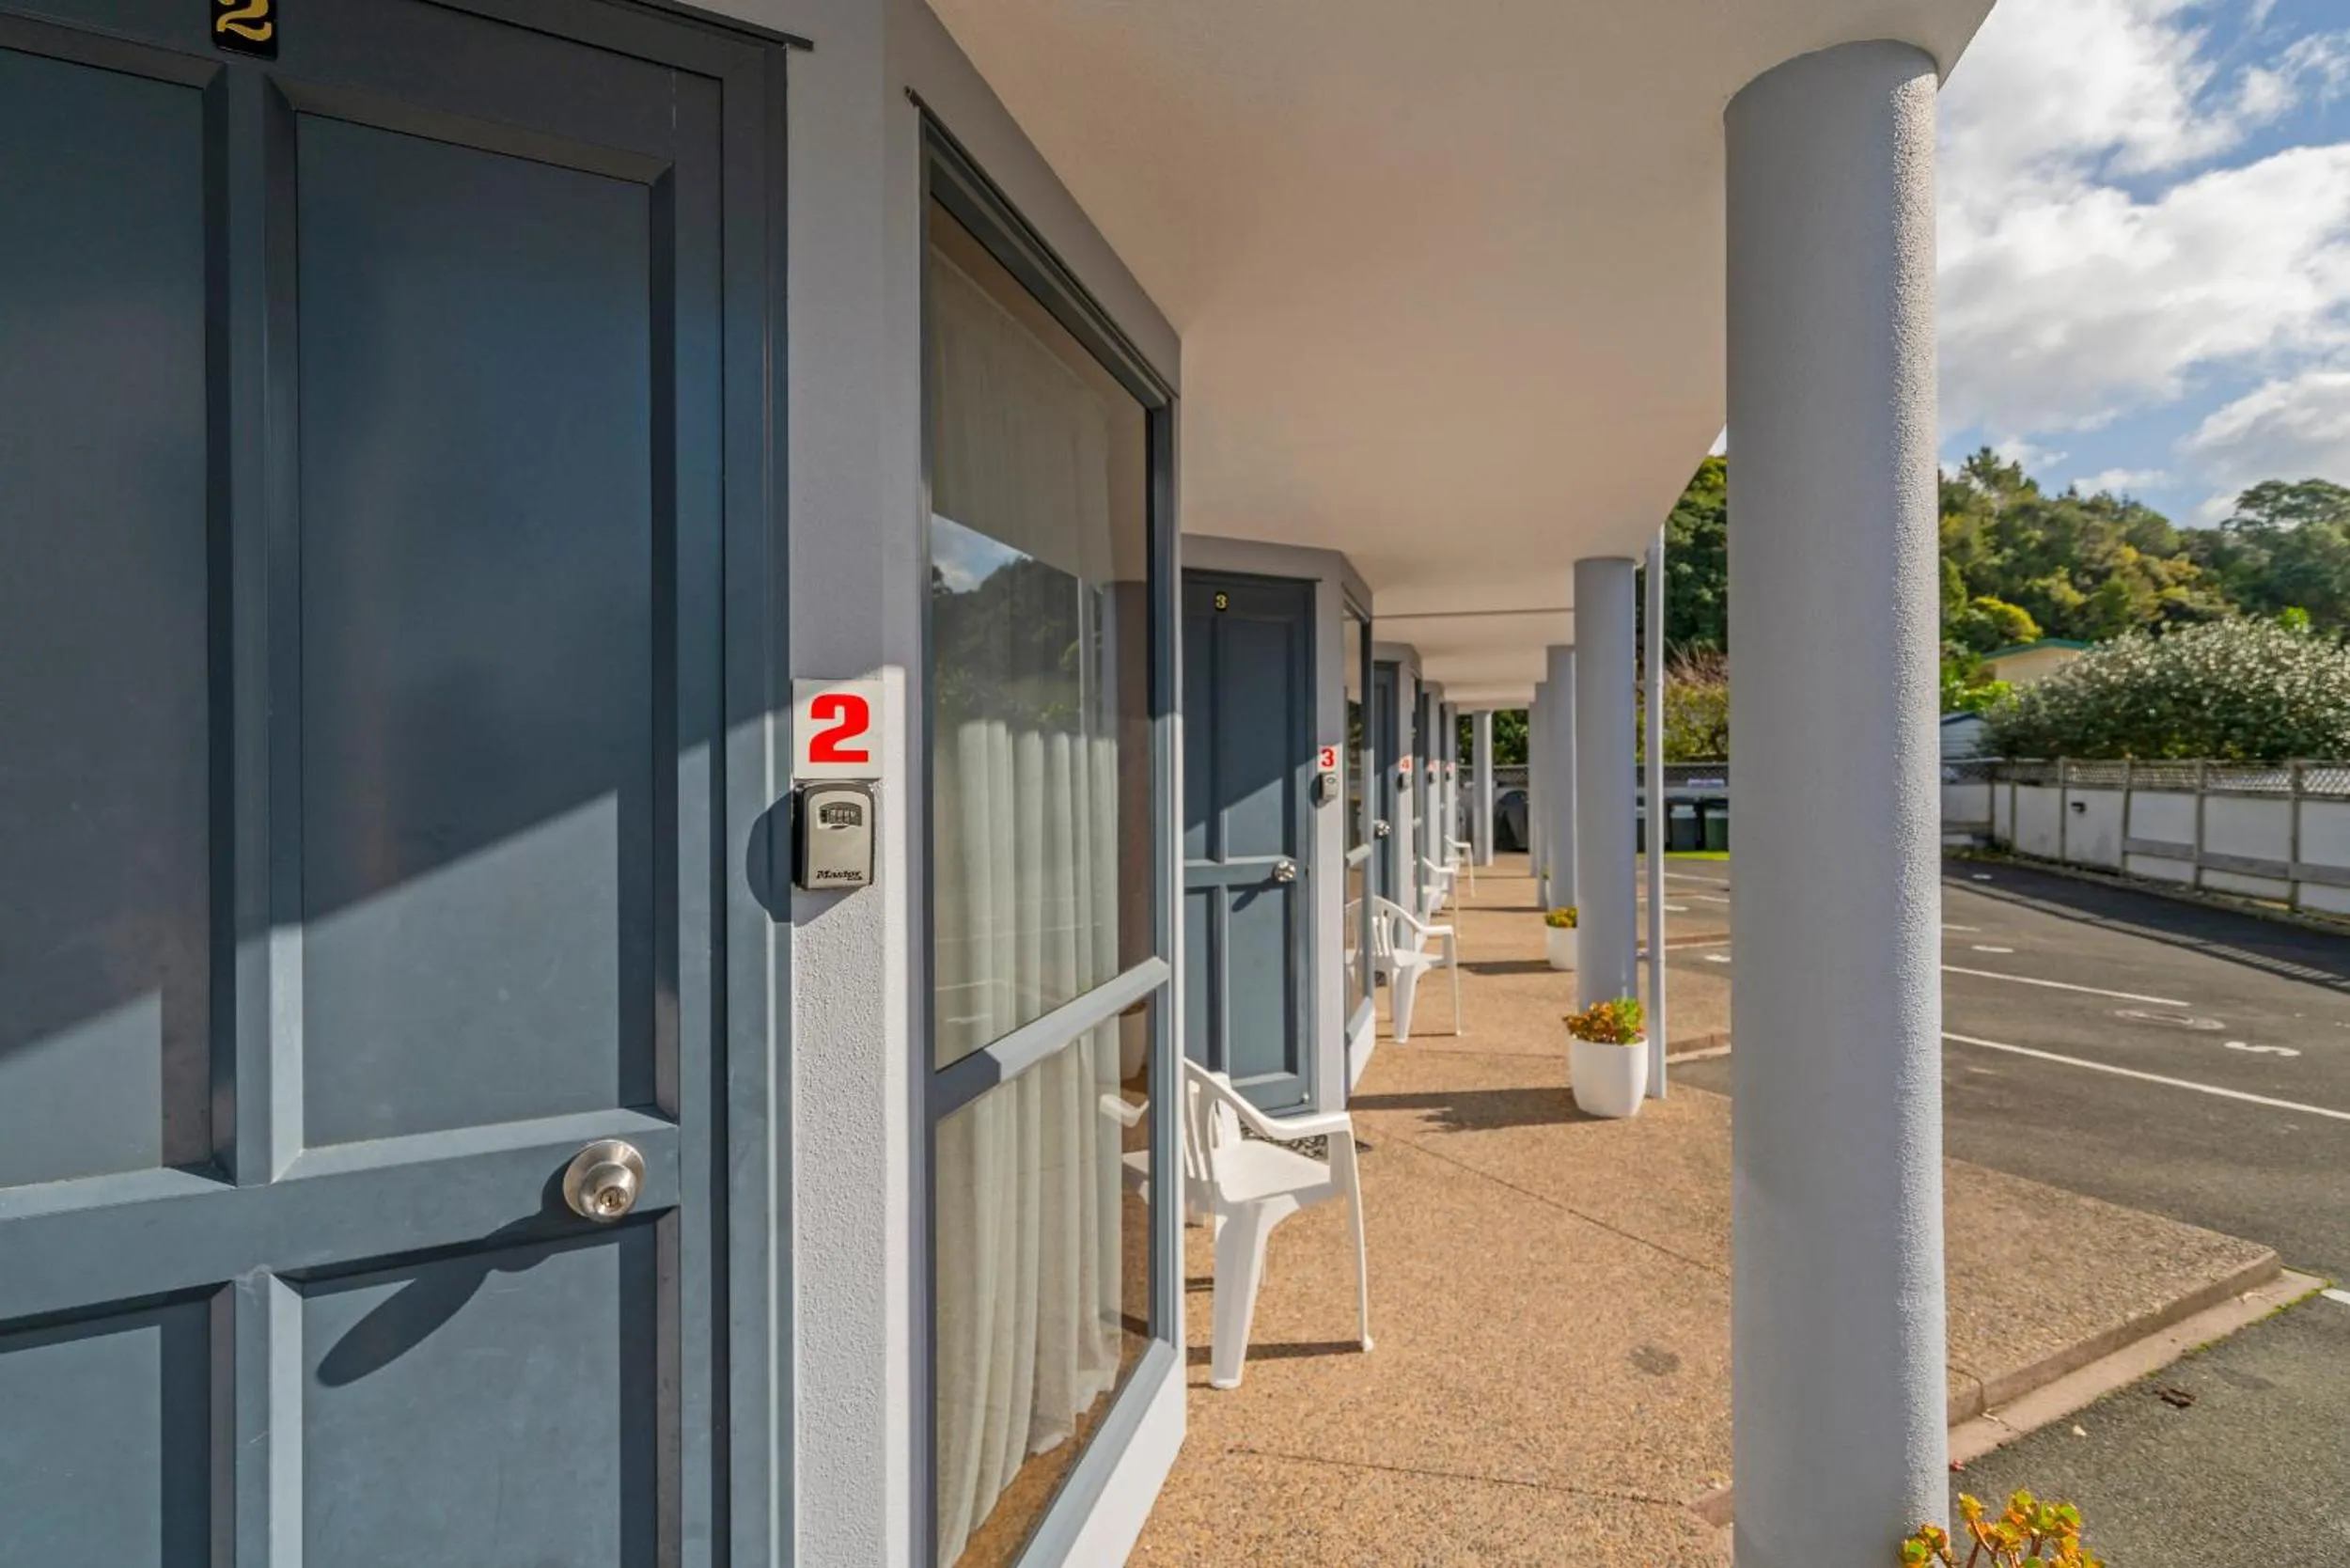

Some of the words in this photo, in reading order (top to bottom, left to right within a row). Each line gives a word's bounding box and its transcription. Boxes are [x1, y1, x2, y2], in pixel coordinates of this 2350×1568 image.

[1215, 594, 1227, 608] 3
[809, 694, 870, 762] 2
[1321, 748, 1334, 767] 3
